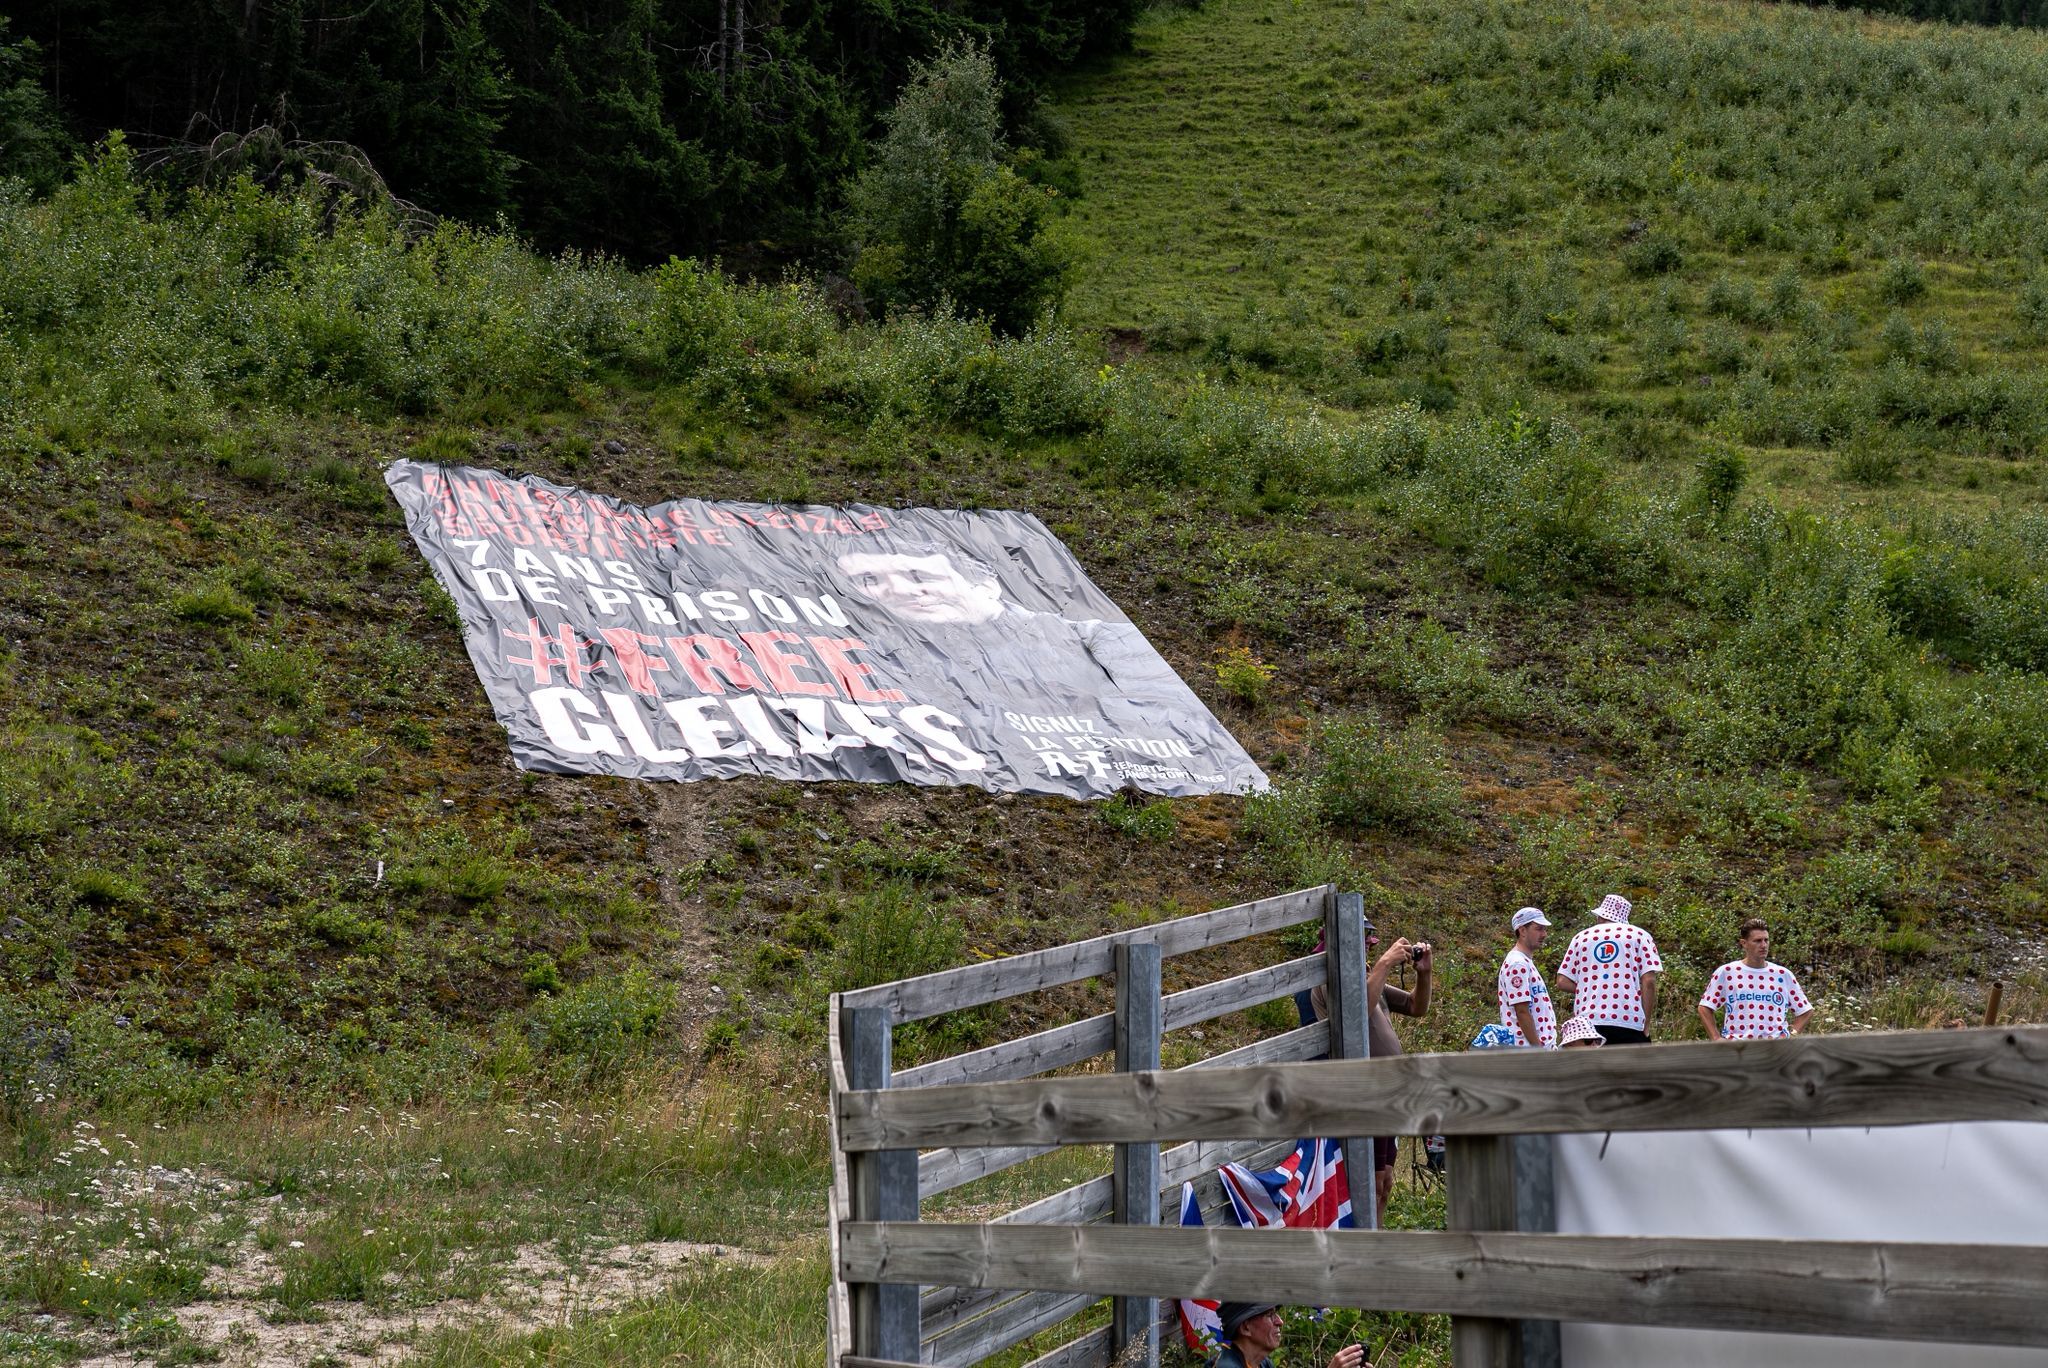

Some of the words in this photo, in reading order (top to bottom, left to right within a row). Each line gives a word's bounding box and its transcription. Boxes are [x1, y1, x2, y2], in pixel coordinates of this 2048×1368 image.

[423, 473, 699, 529] CHRISTHE
[453, 539, 490, 566] 7
[514, 547, 646, 591] ANS
[472, 567, 569, 610] DE
[586, 584, 851, 627] PRISON
[504, 617, 908, 703] #FREE
[529, 687, 987, 771] GLEIZES
[1020, 735, 1064, 750] LA
[1149, 769, 1227, 783] FRONTRES
